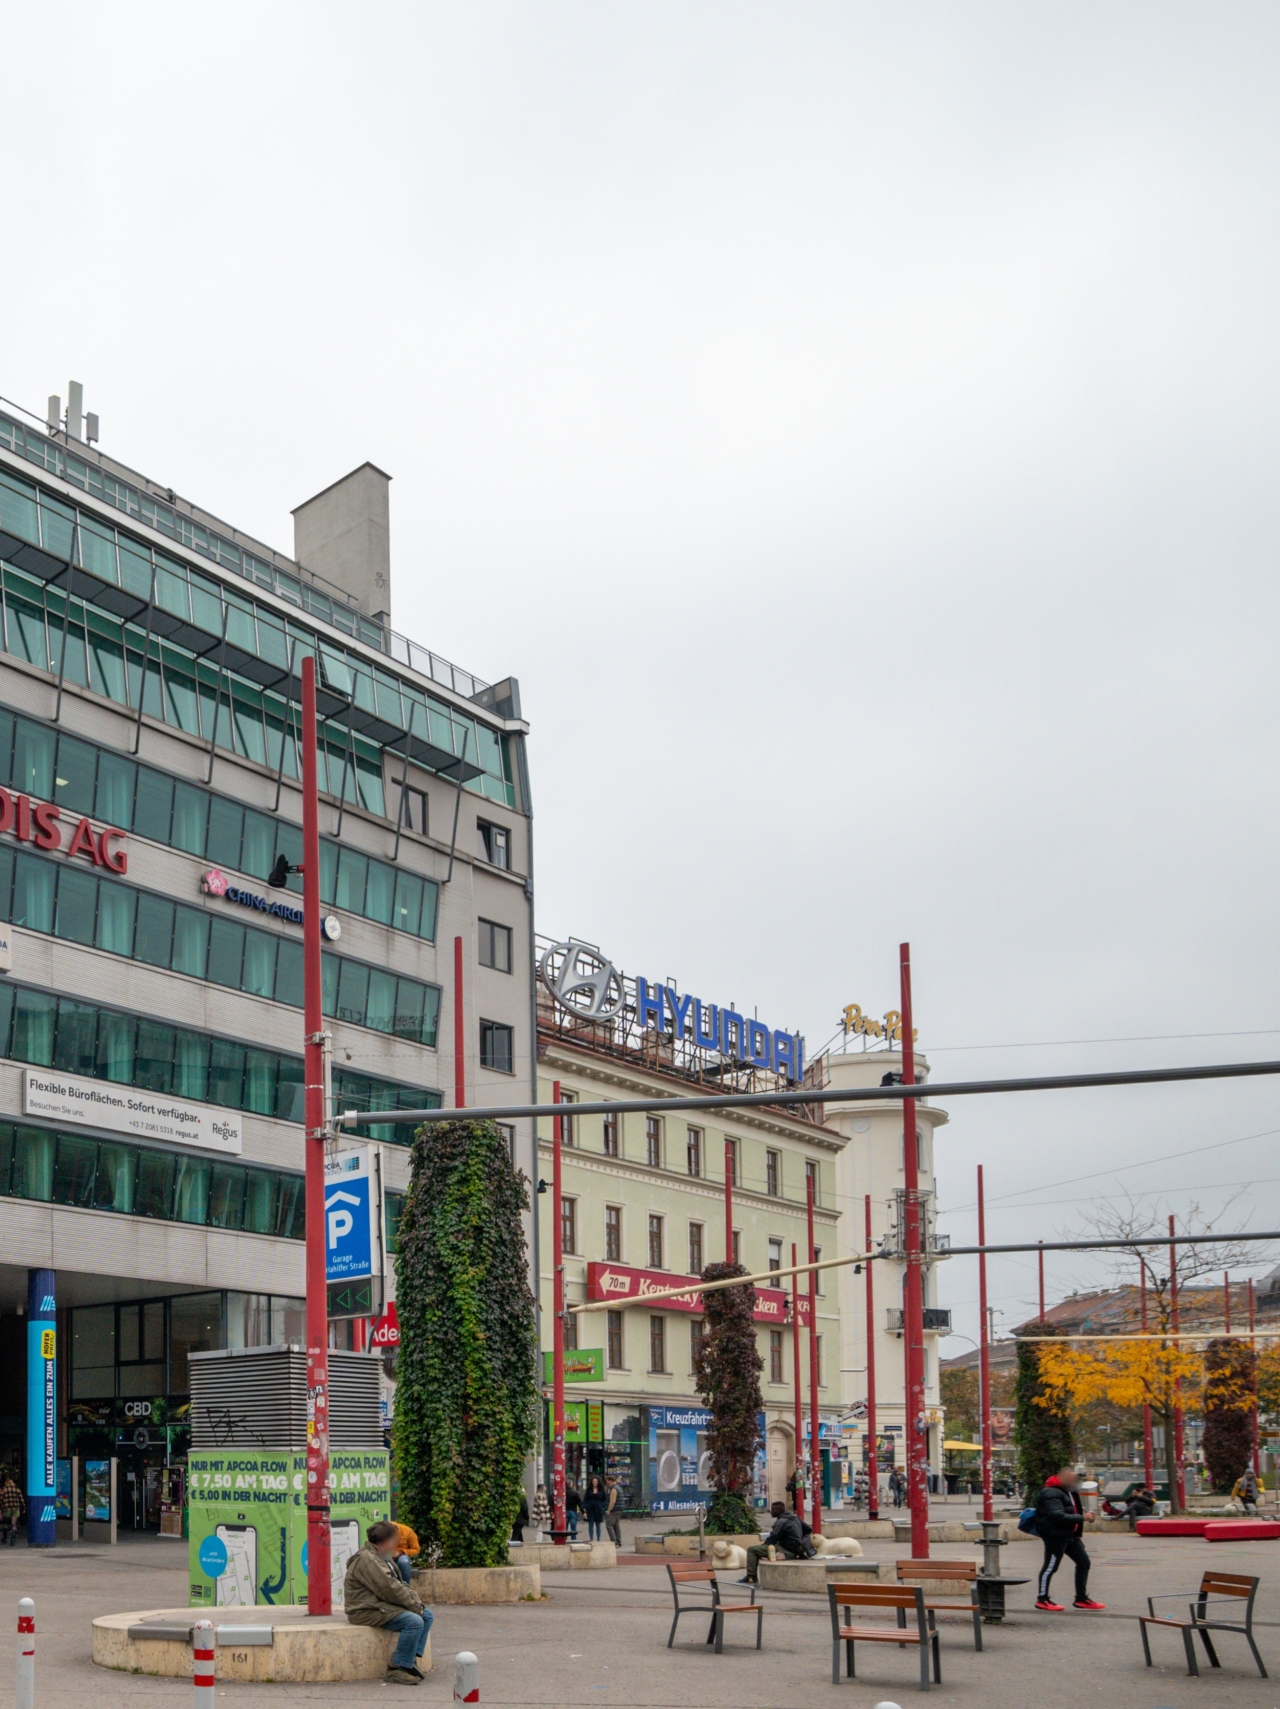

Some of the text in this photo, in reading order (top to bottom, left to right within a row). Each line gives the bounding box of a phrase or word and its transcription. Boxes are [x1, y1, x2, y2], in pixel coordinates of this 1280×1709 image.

[68, 818, 128, 875] AG
[226, 886, 270, 913] CHINA
[635, 975, 804, 1082] HYUNDAI
[843, 1003, 918, 1043] Peter Pae
[29, 1078, 201, 1123] Flexible Büroflächen. Sofort verfügbar.
[29, 1099, 61, 1112] Besuchen
[61, 1106, 72, 1114] Sie
[145, 1122, 159, 1132] 2081
[160, 1125, 174, 1135] 5318
[175, 1129, 199, 1140] regus.at
[212, 1121, 238, 1141] Regus
[328, 1209, 353, 1250] P
[332, 1255, 353, 1264] Garage
[350, 1260, 370, 1270] Straße
[124, 1402, 152, 1416] CBD
[191, 1460, 288, 1473] NUR MIT APCOA FLOW
[294, 1457, 307, 1470] NU
[332, 1457, 386, 1470] APCOA FLOW
[191, 1474, 288, 1490] € 7,50 AM TAG
[293, 1474, 303, 1490] €
[341, 1473, 361, 1488] AM
[363, 1472, 387, 1487] TAG
[191, 1490, 288, 1504] € 5,00 IN DER NACHT
[339, 1493, 356, 1504] DER
[357, 1491, 388, 1503] NACHT
